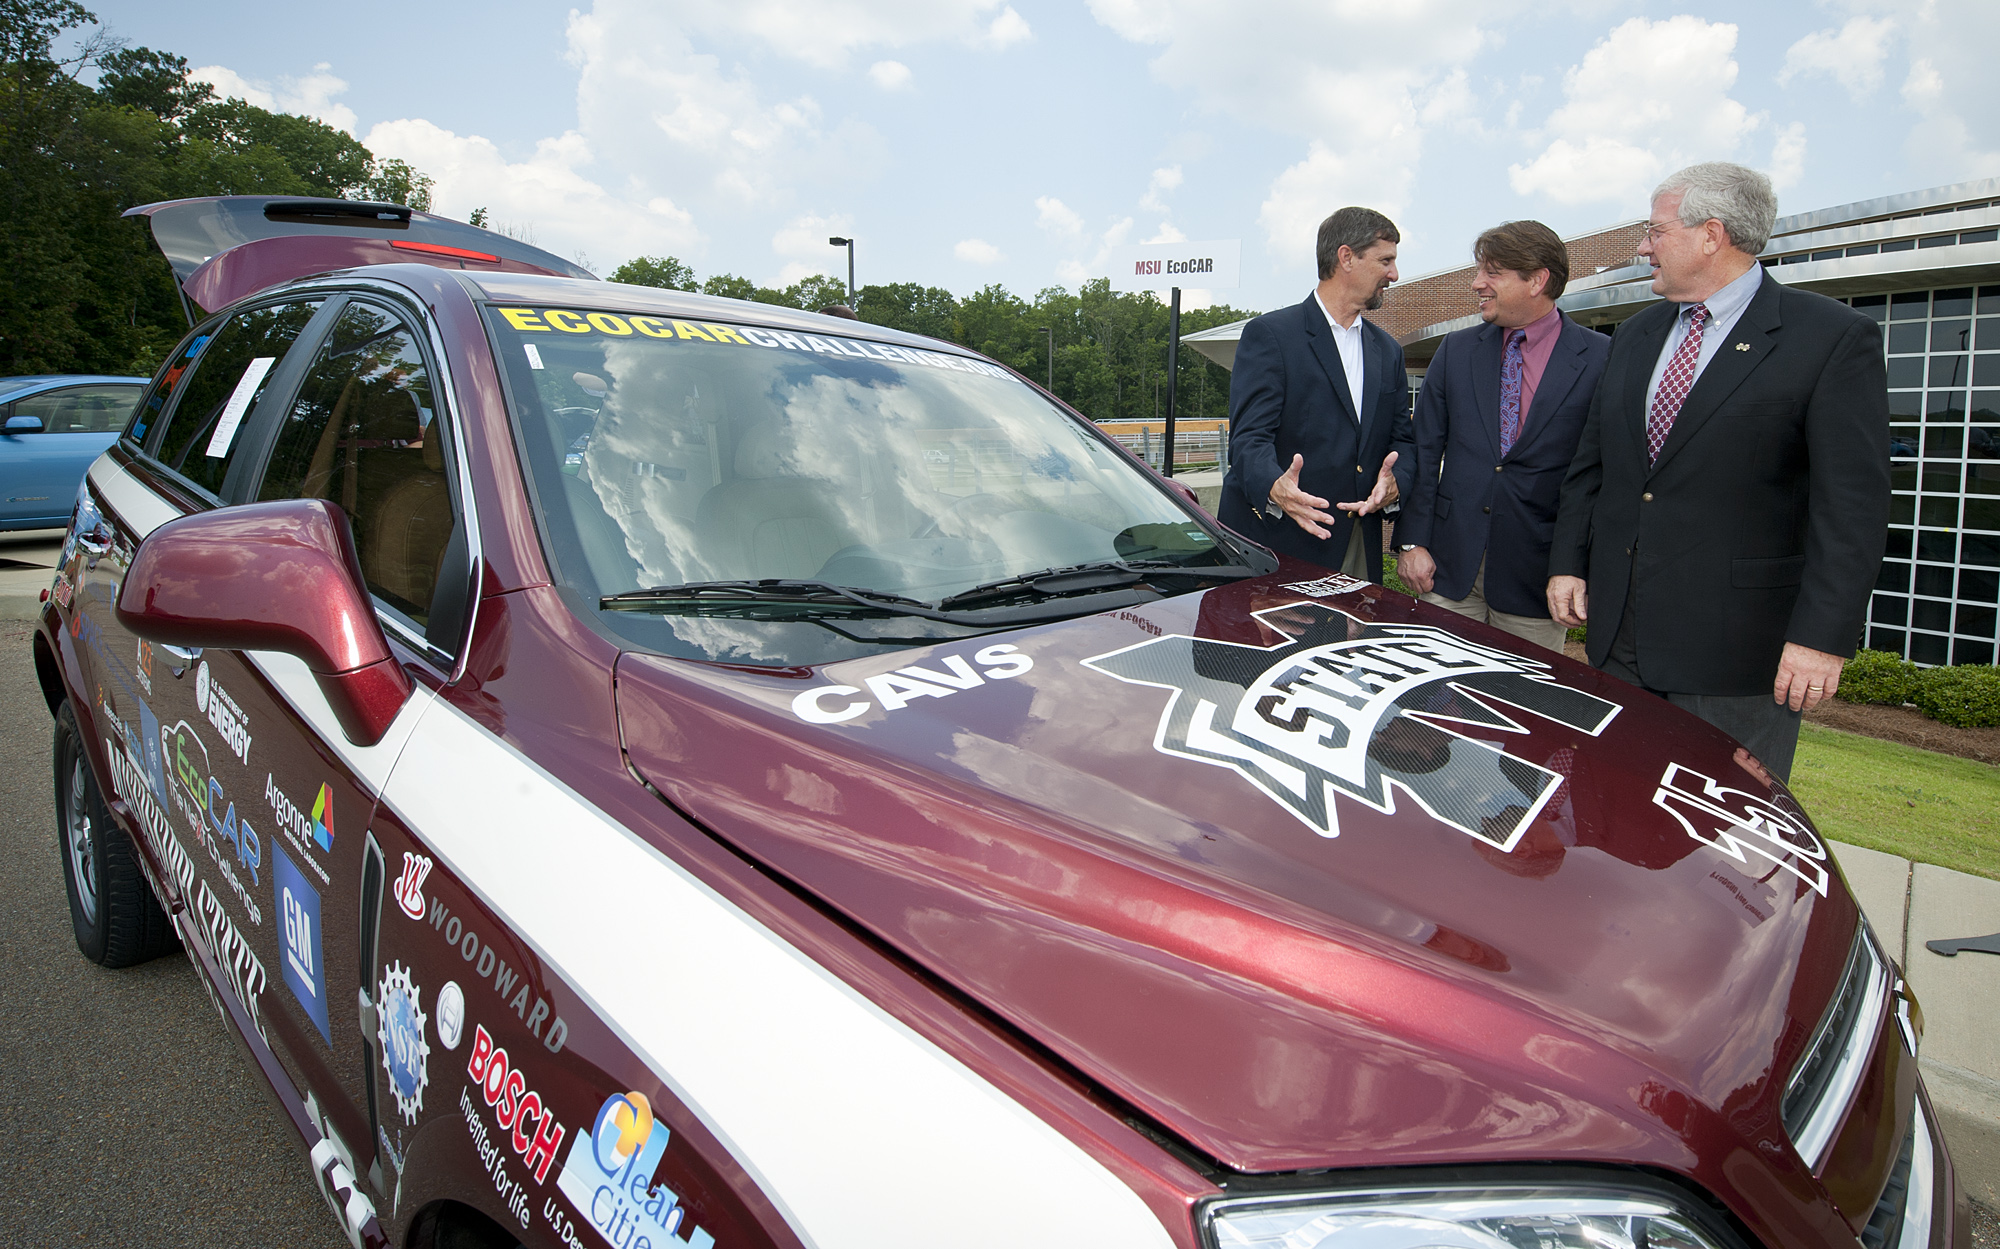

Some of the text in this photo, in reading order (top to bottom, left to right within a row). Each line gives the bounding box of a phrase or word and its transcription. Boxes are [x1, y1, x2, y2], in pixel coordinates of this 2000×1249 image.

[1135, 258, 1213, 275] MSU EcoCAR
[208, 690, 252, 766] ENERGY
[210, 677, 249, 726] U.S. DEPARTMENT OF
[791, 643, 1034, 724] CAVS
[1253, 641, 1473, 750] STATE
[167, 773, 184, 812] The
[206, 833, 262, 926] Challenge
[177, 733, 261, 887] EcoCAR
[264, 772, 312, 849] Argonne
[106, 737, 200, 931] MISSISSIPPI
[197, 878, 270, 1051] STATE
[283, 826, 331, 886] NATIONAL LABORATORY
[282, 886, 314, 976] GM
[428, 896, 569, 1054] WOODWARD
[385, 1006, 421, 1078] NSF
[467, 1023, 566, 1185] BOSCH
[459, 1085, 531, 1231] Invented for life
[592, 1092, 686, 1240] Clean
[542, 1196, 564, 1236] U.S.
